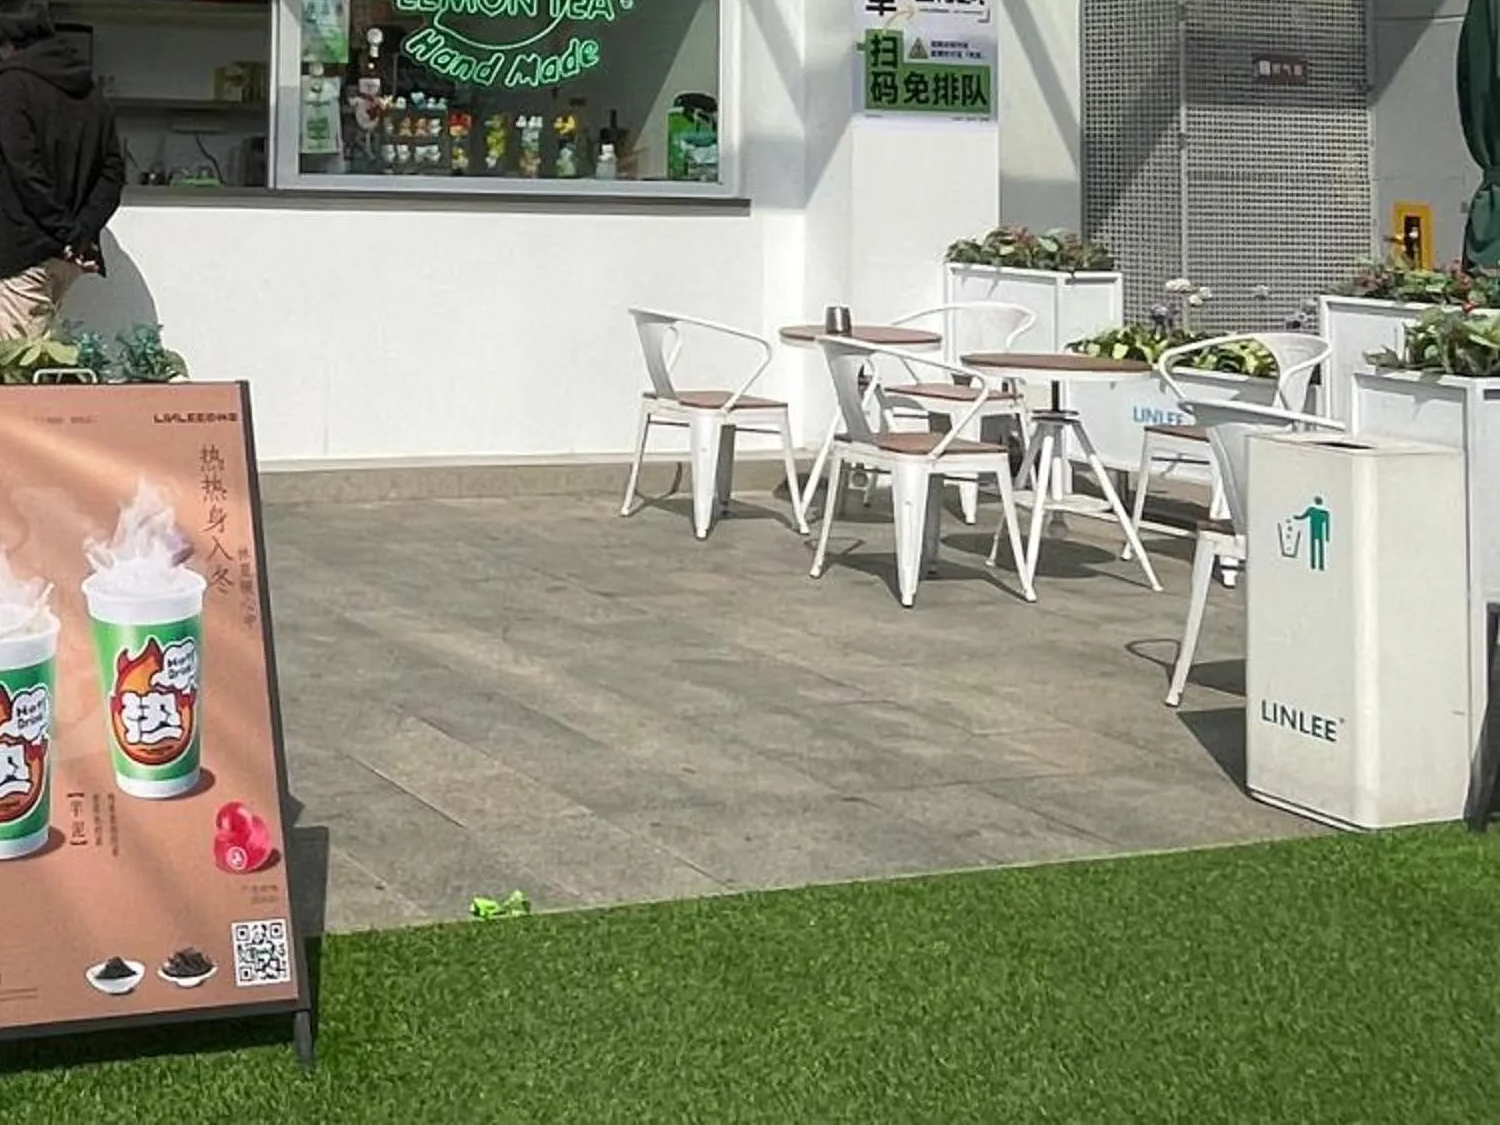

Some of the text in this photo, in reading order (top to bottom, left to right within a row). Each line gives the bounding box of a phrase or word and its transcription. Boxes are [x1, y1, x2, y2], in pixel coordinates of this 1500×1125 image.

[405, 27, 600, 88] Hand Made
[1261, 698, 1337, 743] LINLEE
